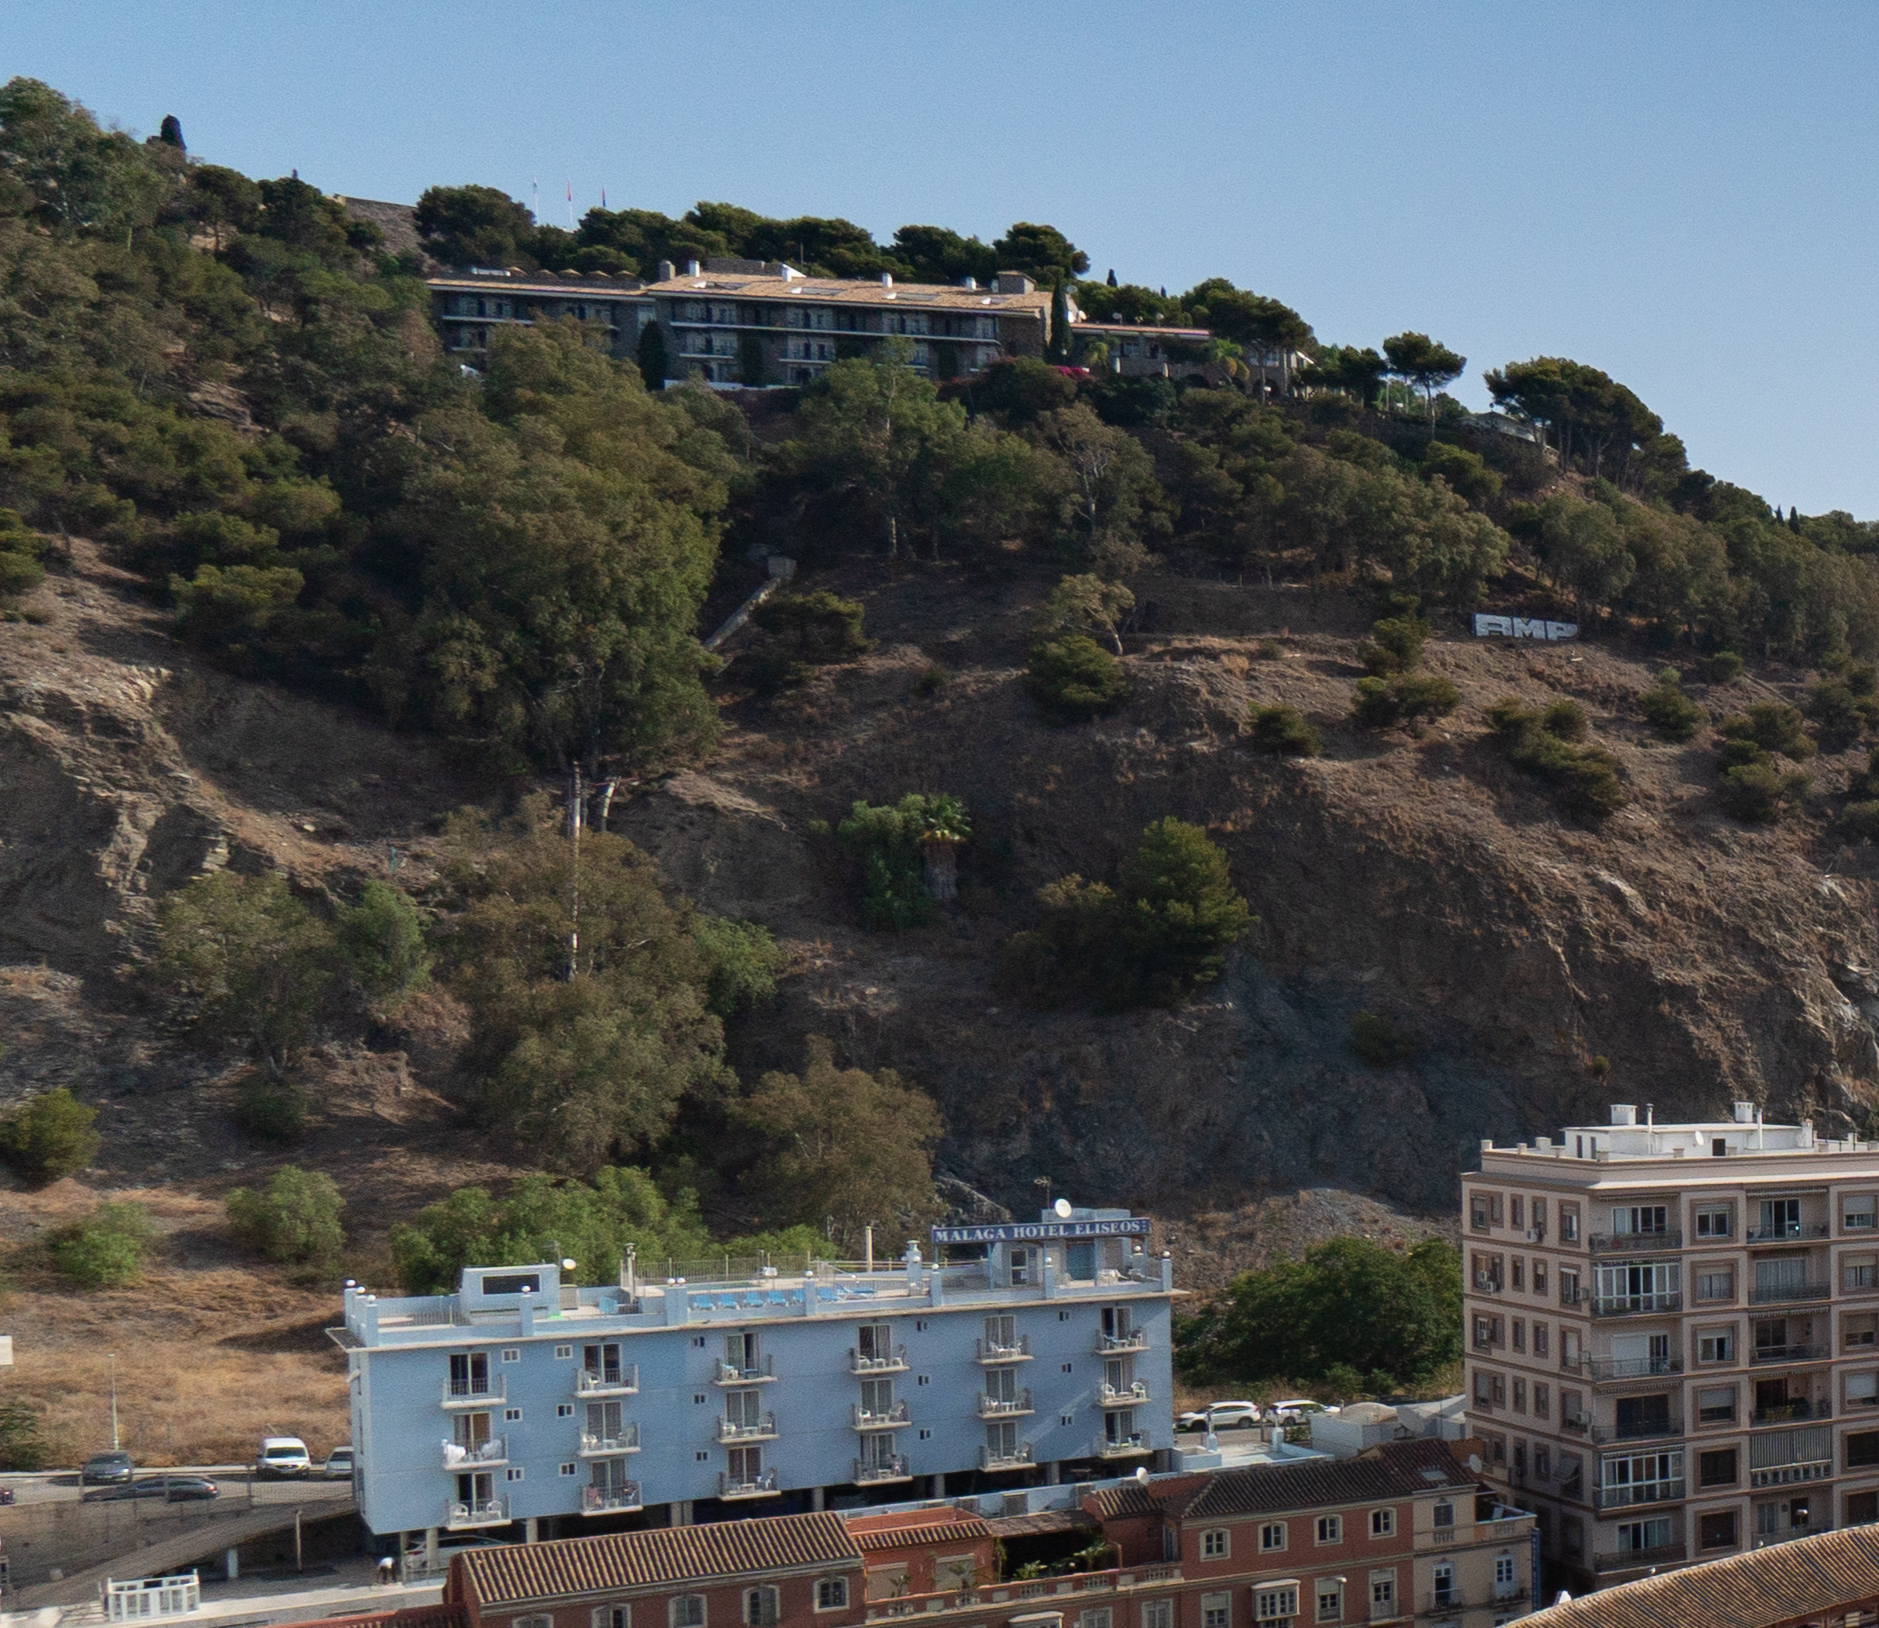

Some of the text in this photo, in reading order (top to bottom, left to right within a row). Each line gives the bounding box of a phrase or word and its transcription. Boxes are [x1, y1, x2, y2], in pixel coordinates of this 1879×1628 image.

[935, 1220, 1140, 1242] MALAGA HOTEL ELISEOS
